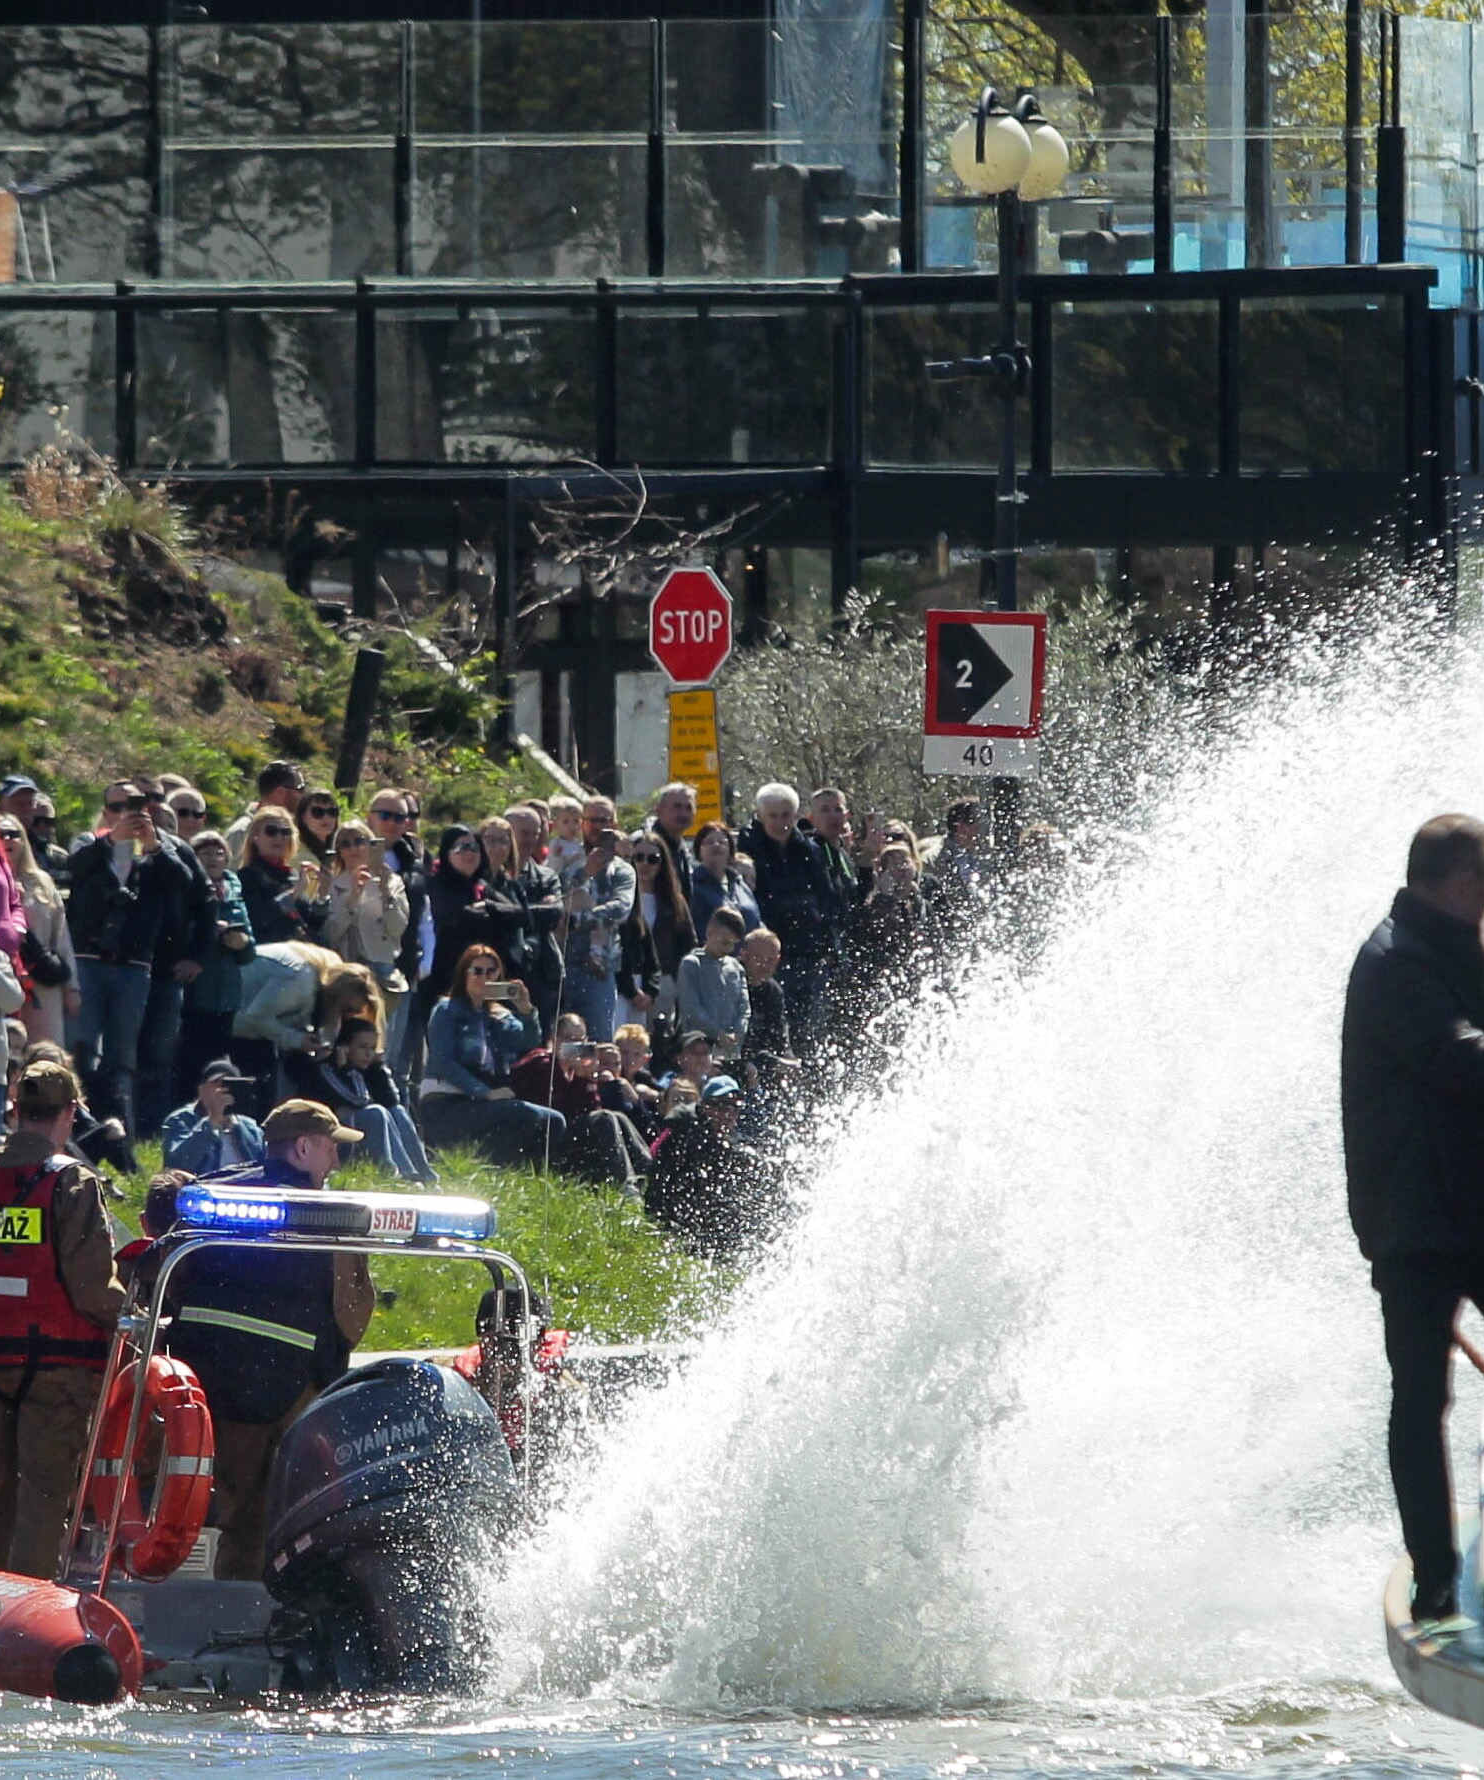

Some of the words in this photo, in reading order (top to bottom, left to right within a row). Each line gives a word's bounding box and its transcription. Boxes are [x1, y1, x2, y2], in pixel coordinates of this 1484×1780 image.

[660, 609, 723, 644] STOP
[955, 659, 973, 688] 2
[962, 744, 993, 766] 40
[352, 1416, 430, 1456] YAMAHA
